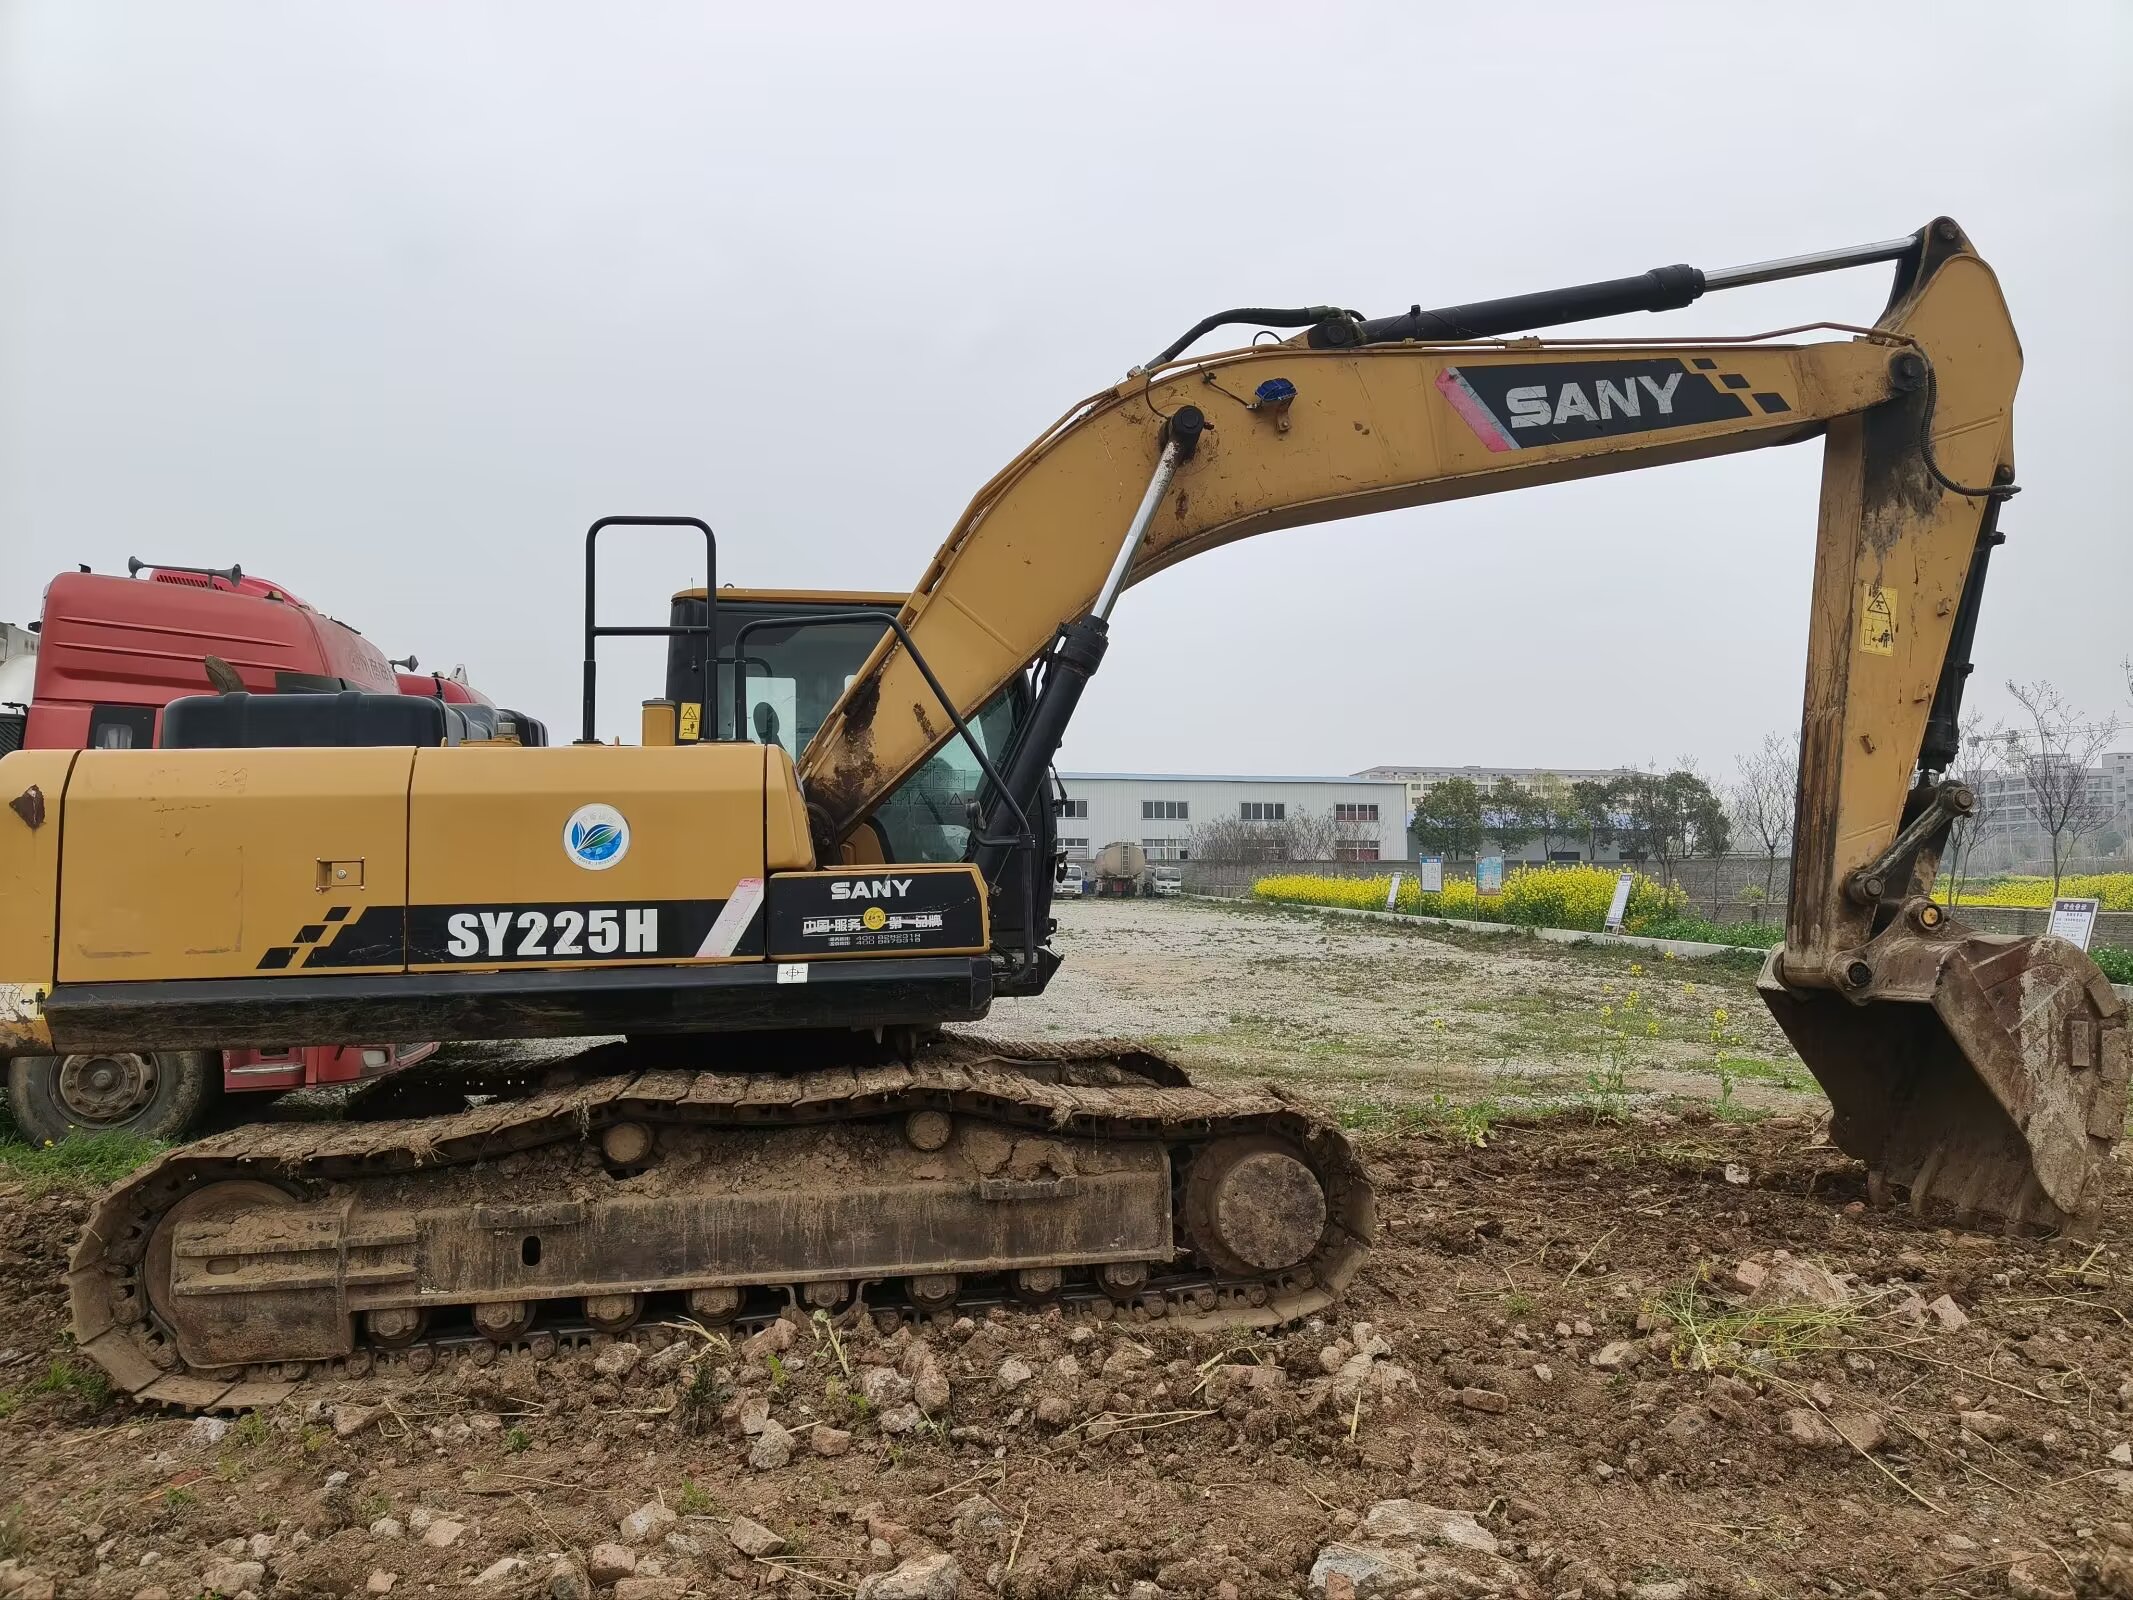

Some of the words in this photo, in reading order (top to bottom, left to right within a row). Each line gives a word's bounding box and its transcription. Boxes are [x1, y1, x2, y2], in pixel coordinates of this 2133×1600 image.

[1506, 372, 1683, 429] SANY
[830, 879, 912, 900] SANY
[447, 908, 658, 957] SY225H
